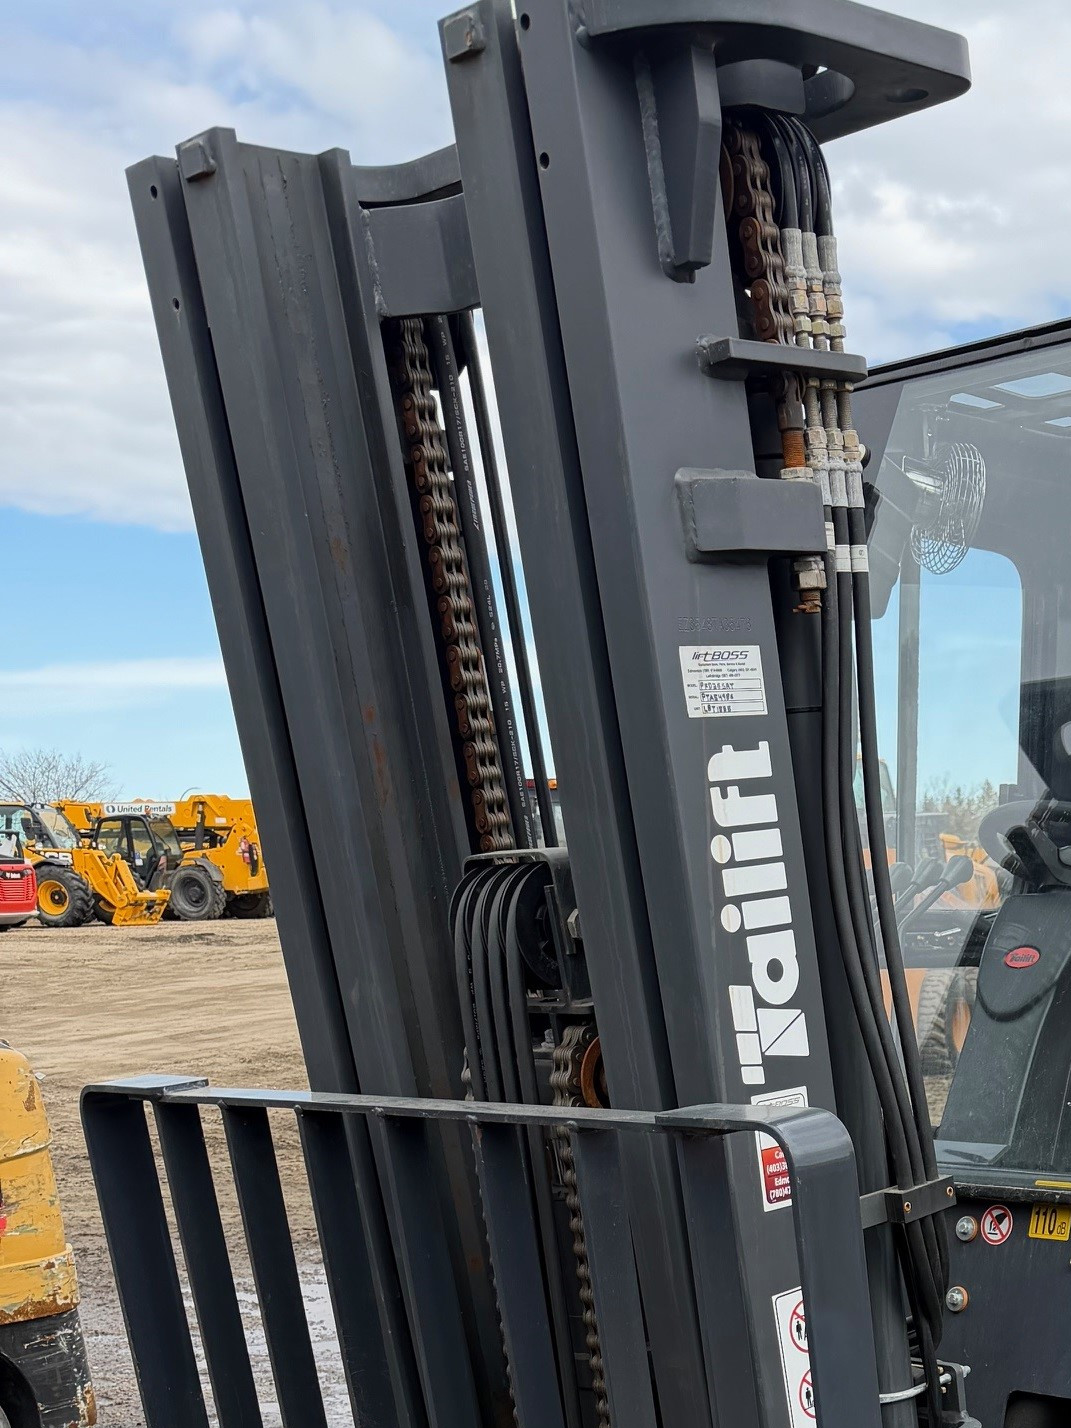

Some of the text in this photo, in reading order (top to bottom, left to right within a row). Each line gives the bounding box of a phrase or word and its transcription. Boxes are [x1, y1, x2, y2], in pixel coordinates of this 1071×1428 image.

[117, 805, 142, 813] United
[708, 741, 810, 1085] Tailift
[1034, 1206, 1058, 1236] 110
